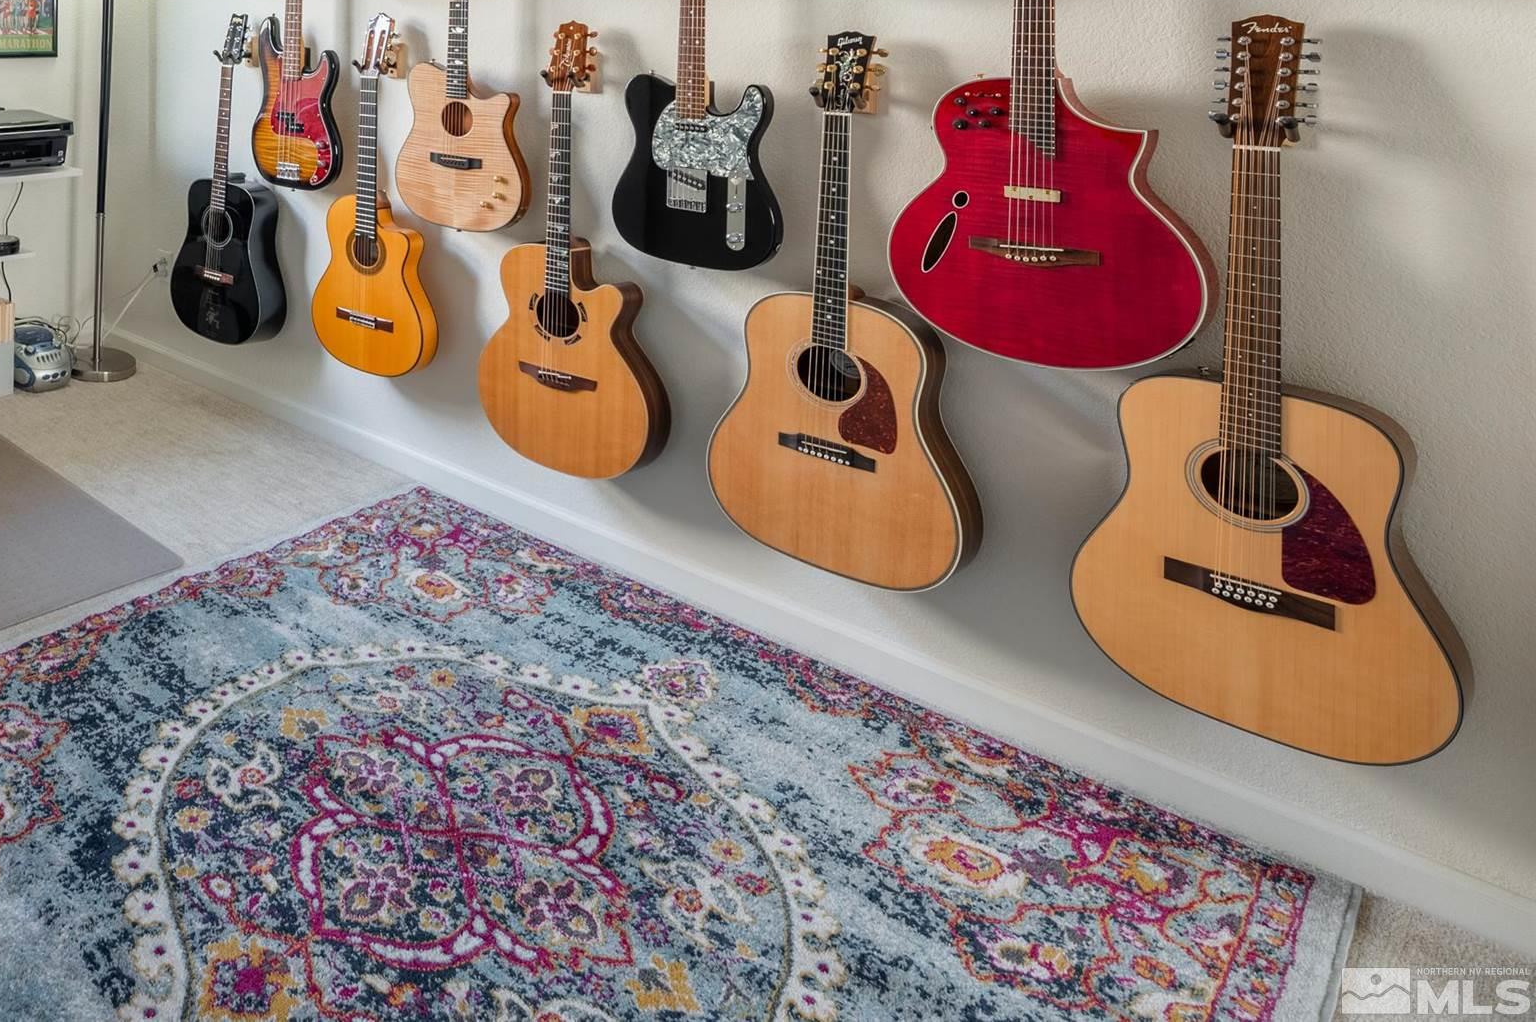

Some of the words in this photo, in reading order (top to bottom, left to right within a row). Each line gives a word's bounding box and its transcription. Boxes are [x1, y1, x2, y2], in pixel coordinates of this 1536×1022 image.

[1241, 21, 1290, 34] Fender
[0, 38, 52, 51] MARATHON
[837, 36, 863, 48] Gibson
